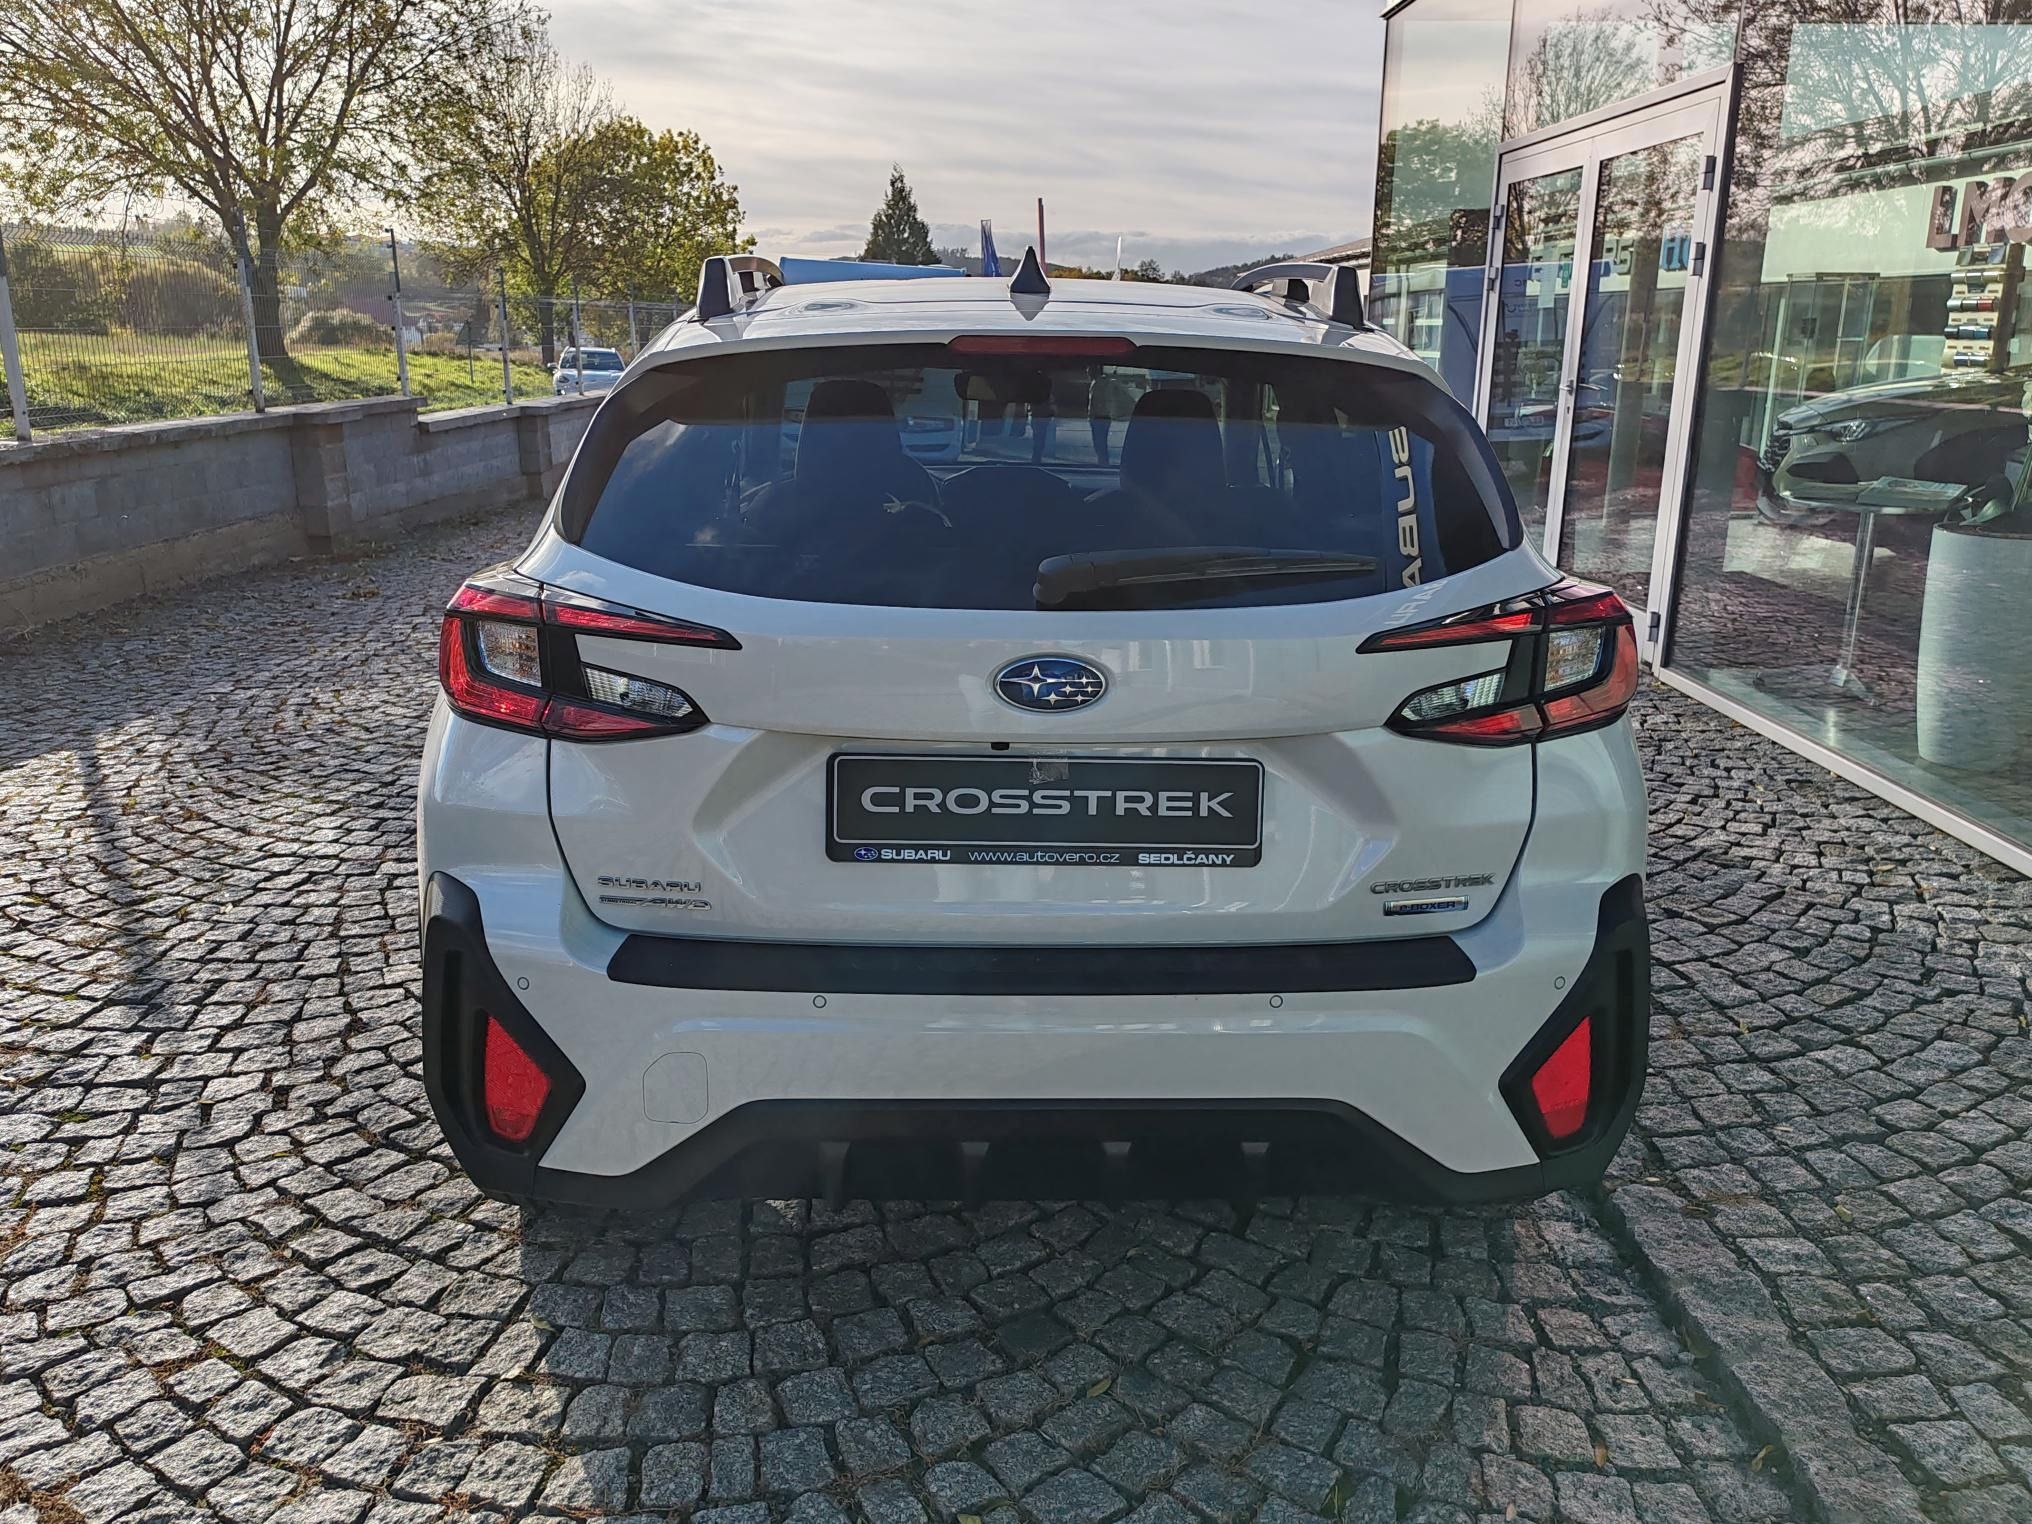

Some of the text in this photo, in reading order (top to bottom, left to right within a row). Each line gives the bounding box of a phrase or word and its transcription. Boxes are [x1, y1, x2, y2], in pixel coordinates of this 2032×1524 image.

[861, 786, 1235, 818] CROSSTREK
[880, 849, 1235, 865] SUBARU www.autovero.cz SEDLČANY
[598, 875, 702, 892] SUBARU
[1369, 873, 1496, 895] CROSSTREK
